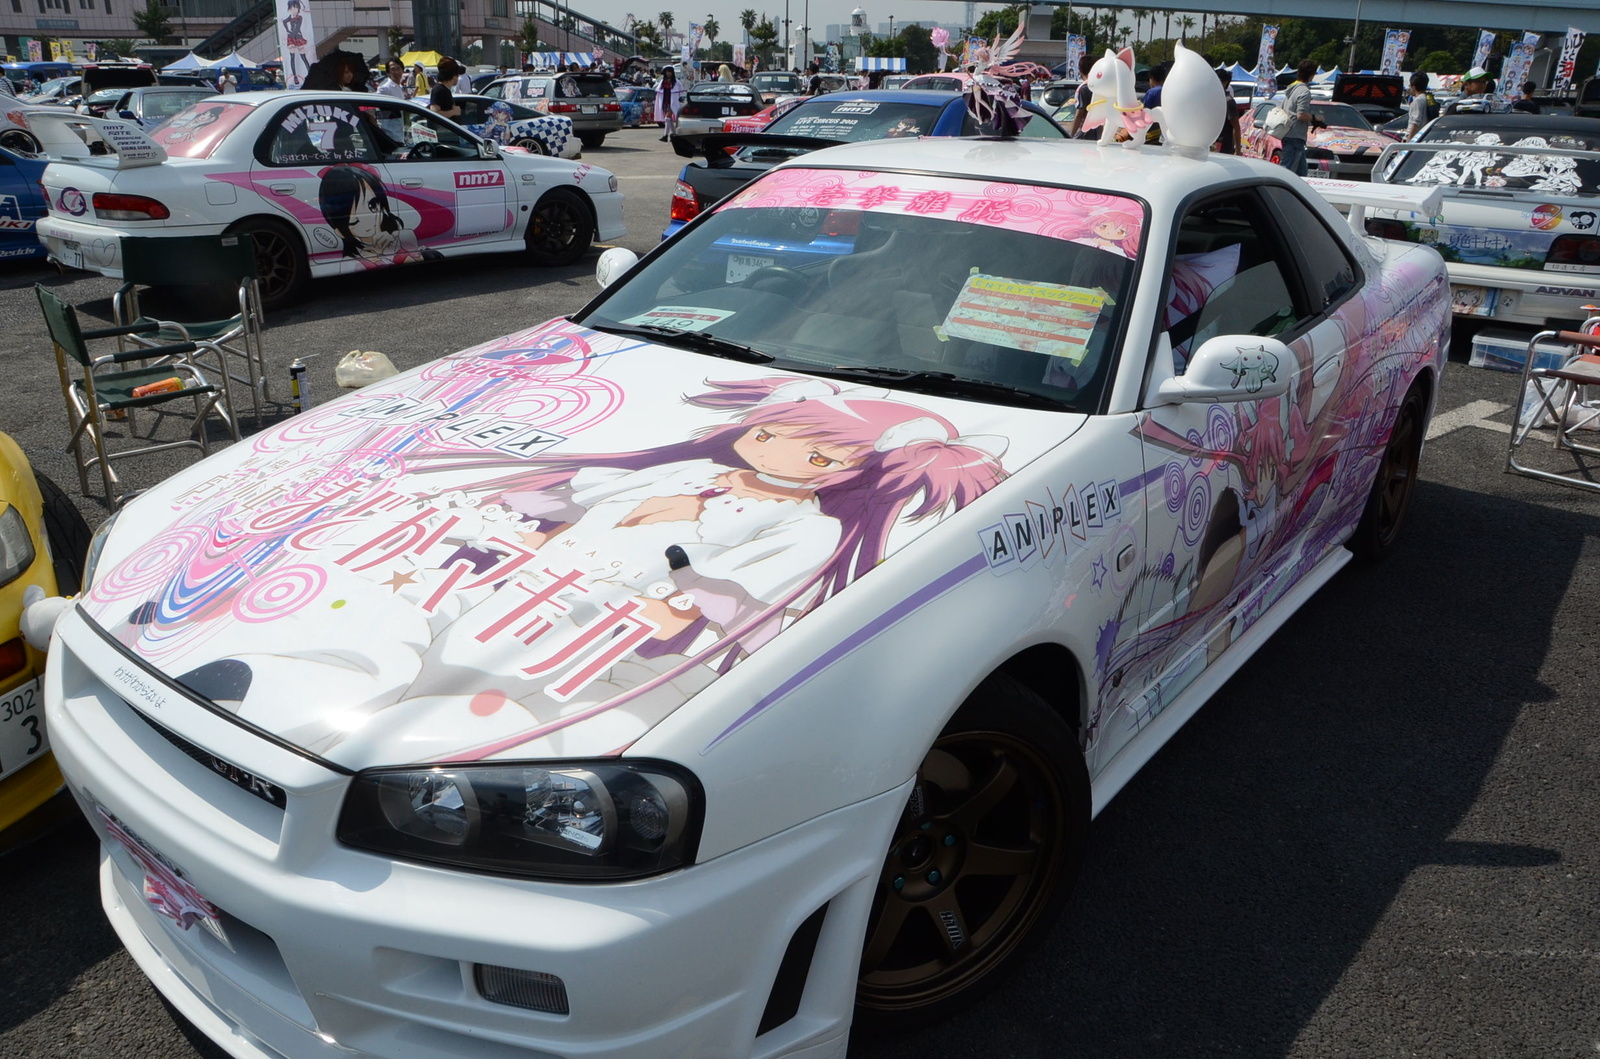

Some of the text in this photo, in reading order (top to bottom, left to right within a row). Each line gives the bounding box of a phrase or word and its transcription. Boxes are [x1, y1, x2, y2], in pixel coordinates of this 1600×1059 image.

[281, 104, 360, 133] MIZUKI
[307, 121, 338, 150] 7
[459, 172, 500, 186] nm7
[1449, 232, 1503, 250] 夏色キセキ
[1535, 286, 1596, 298] ADVAN
[1020, 329, 1050, 339] POINT
[427, 485, 535, 531] MADOKA
[992, 485, 1116, 560] ANIPLEX
[562, 538, 692, 607] MAGICA
[0, 688, 36, 722] 302
